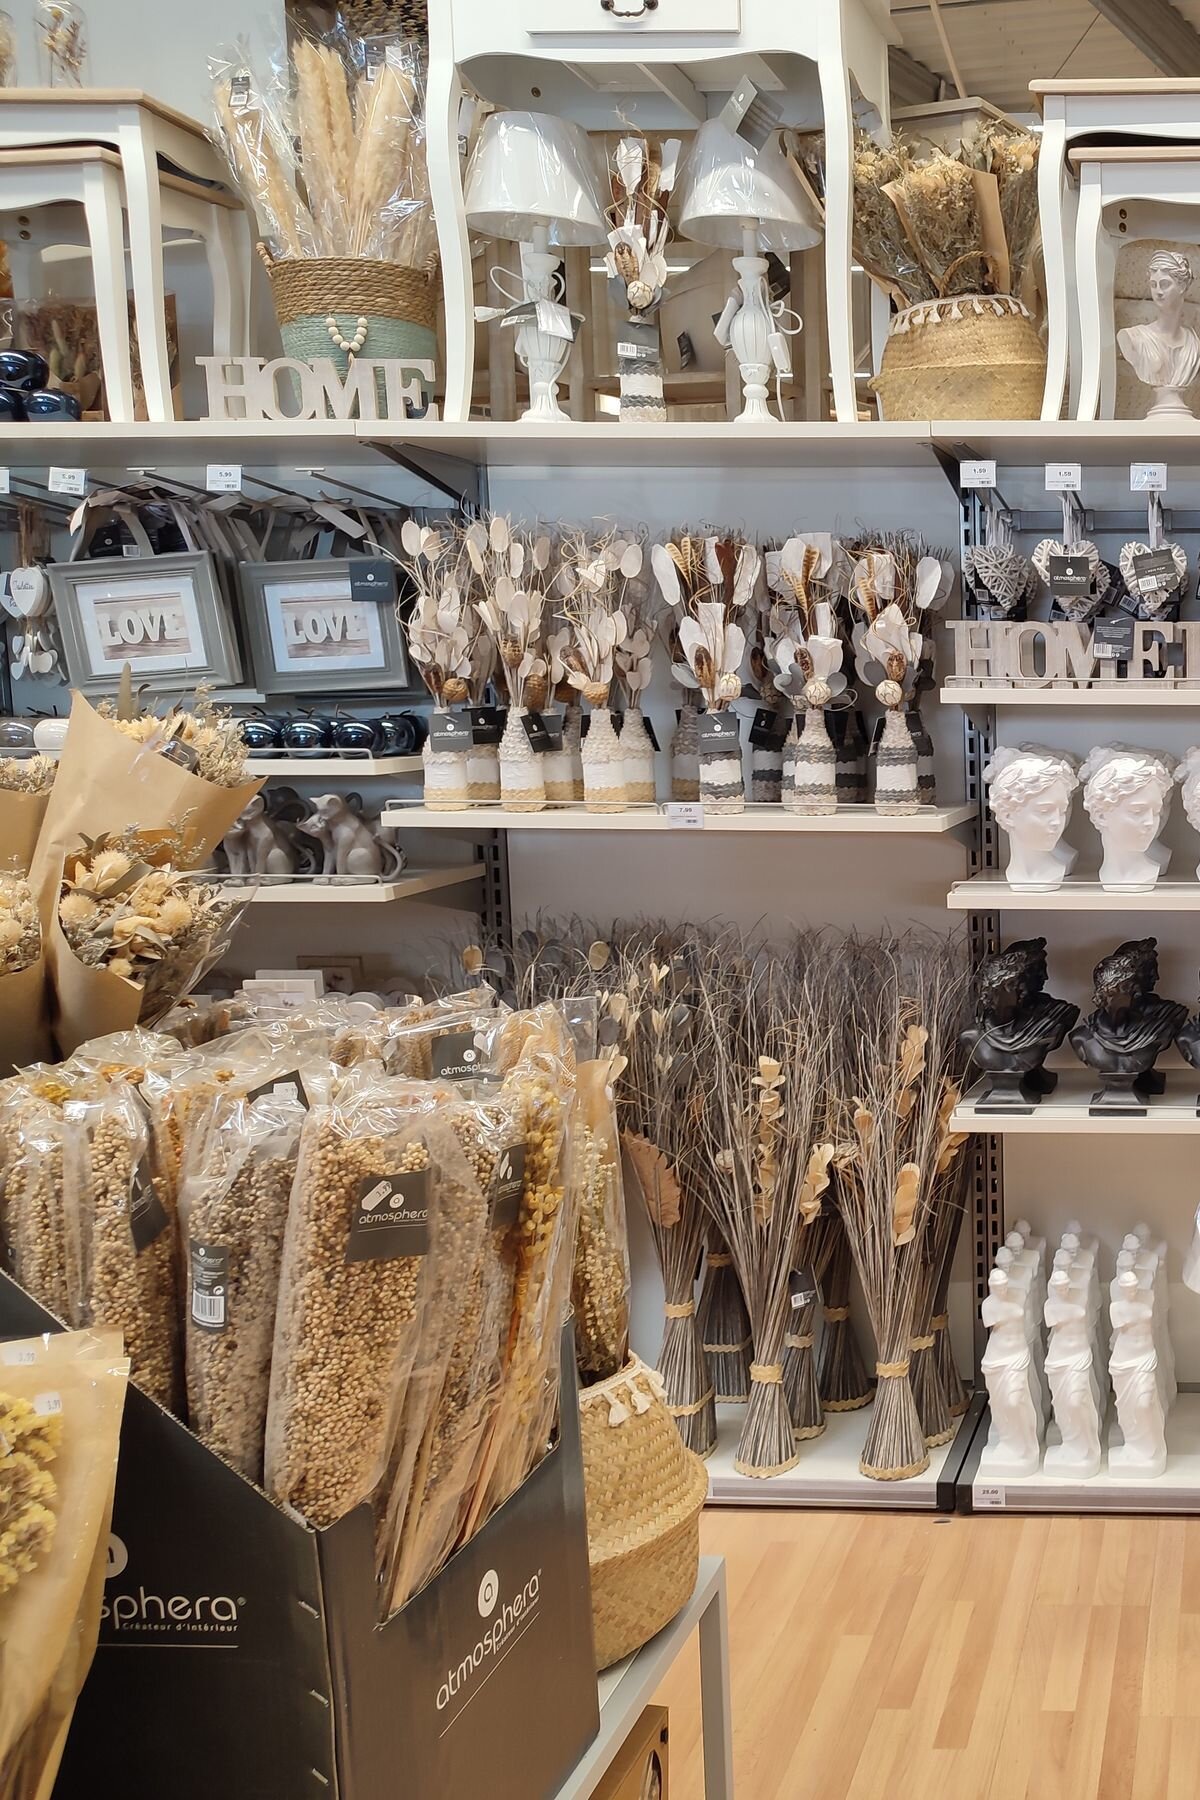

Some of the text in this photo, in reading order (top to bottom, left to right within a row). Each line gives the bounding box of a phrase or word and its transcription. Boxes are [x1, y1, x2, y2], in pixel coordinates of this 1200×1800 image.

[195, 356, 436, 421] HOME
[98, 608, 187, 646] LOVE
[282, 608, 368, 646] LOVE
[945, 620, 1175, 689] HOME
[436, 1574, 539, 1710] atmosphera
